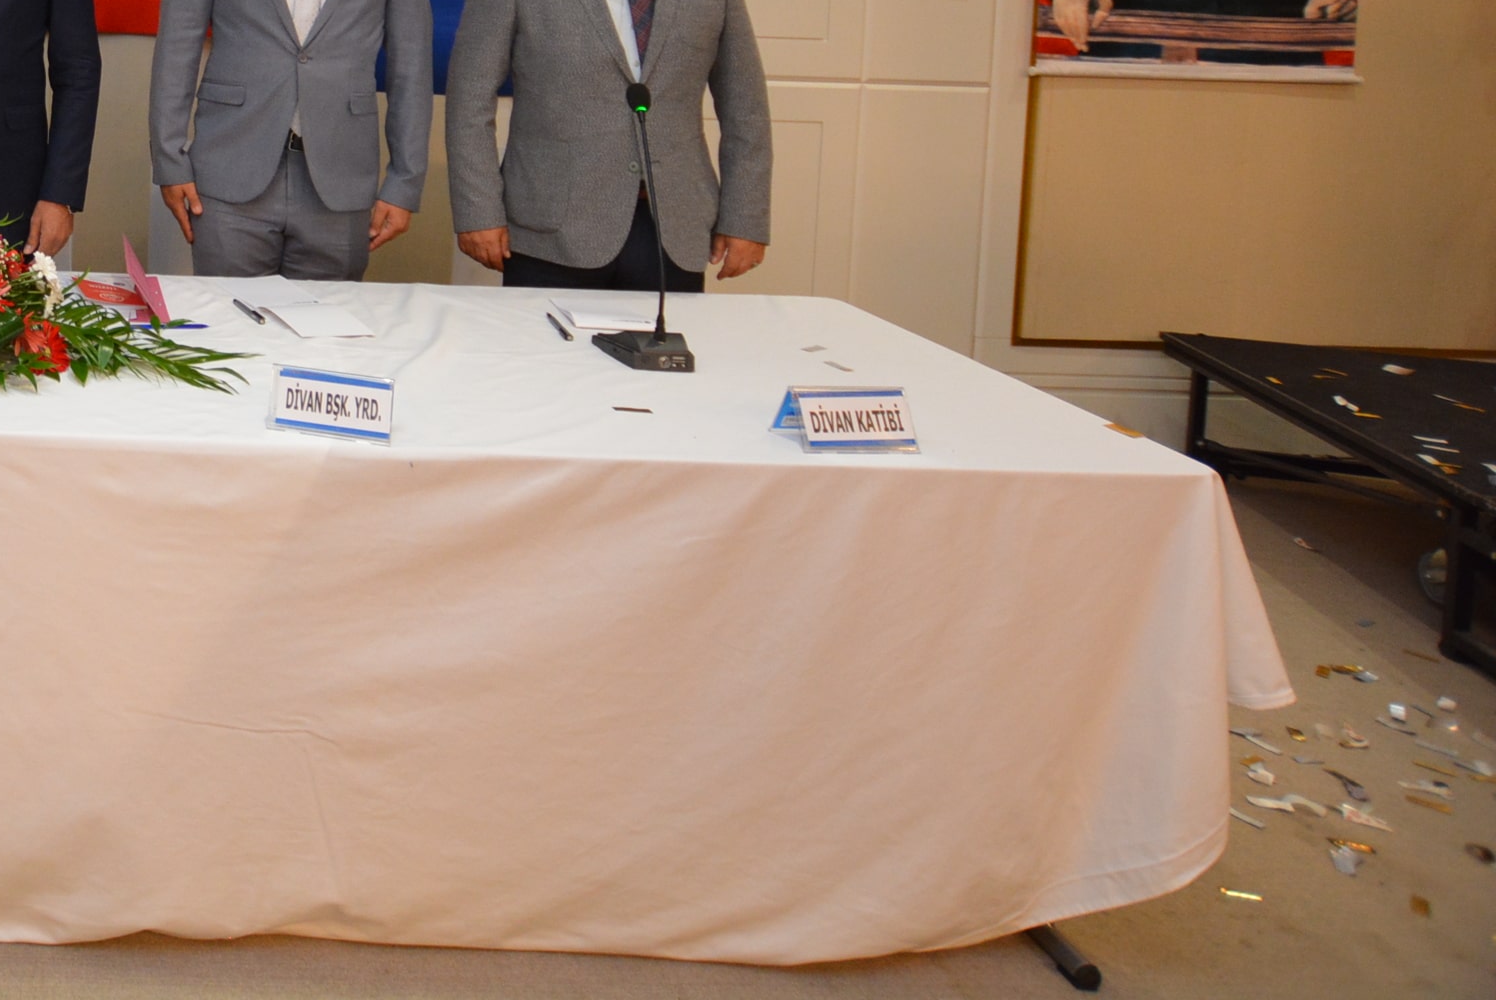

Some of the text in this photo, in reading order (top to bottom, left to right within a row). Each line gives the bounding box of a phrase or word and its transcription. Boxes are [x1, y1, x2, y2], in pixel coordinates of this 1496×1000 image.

[285, 382, 382, 422] DİVAN BŞK. YRD.
[808, 404, 855, 434] DİVAN
[854, 403, 905, 433] KATİBİ
